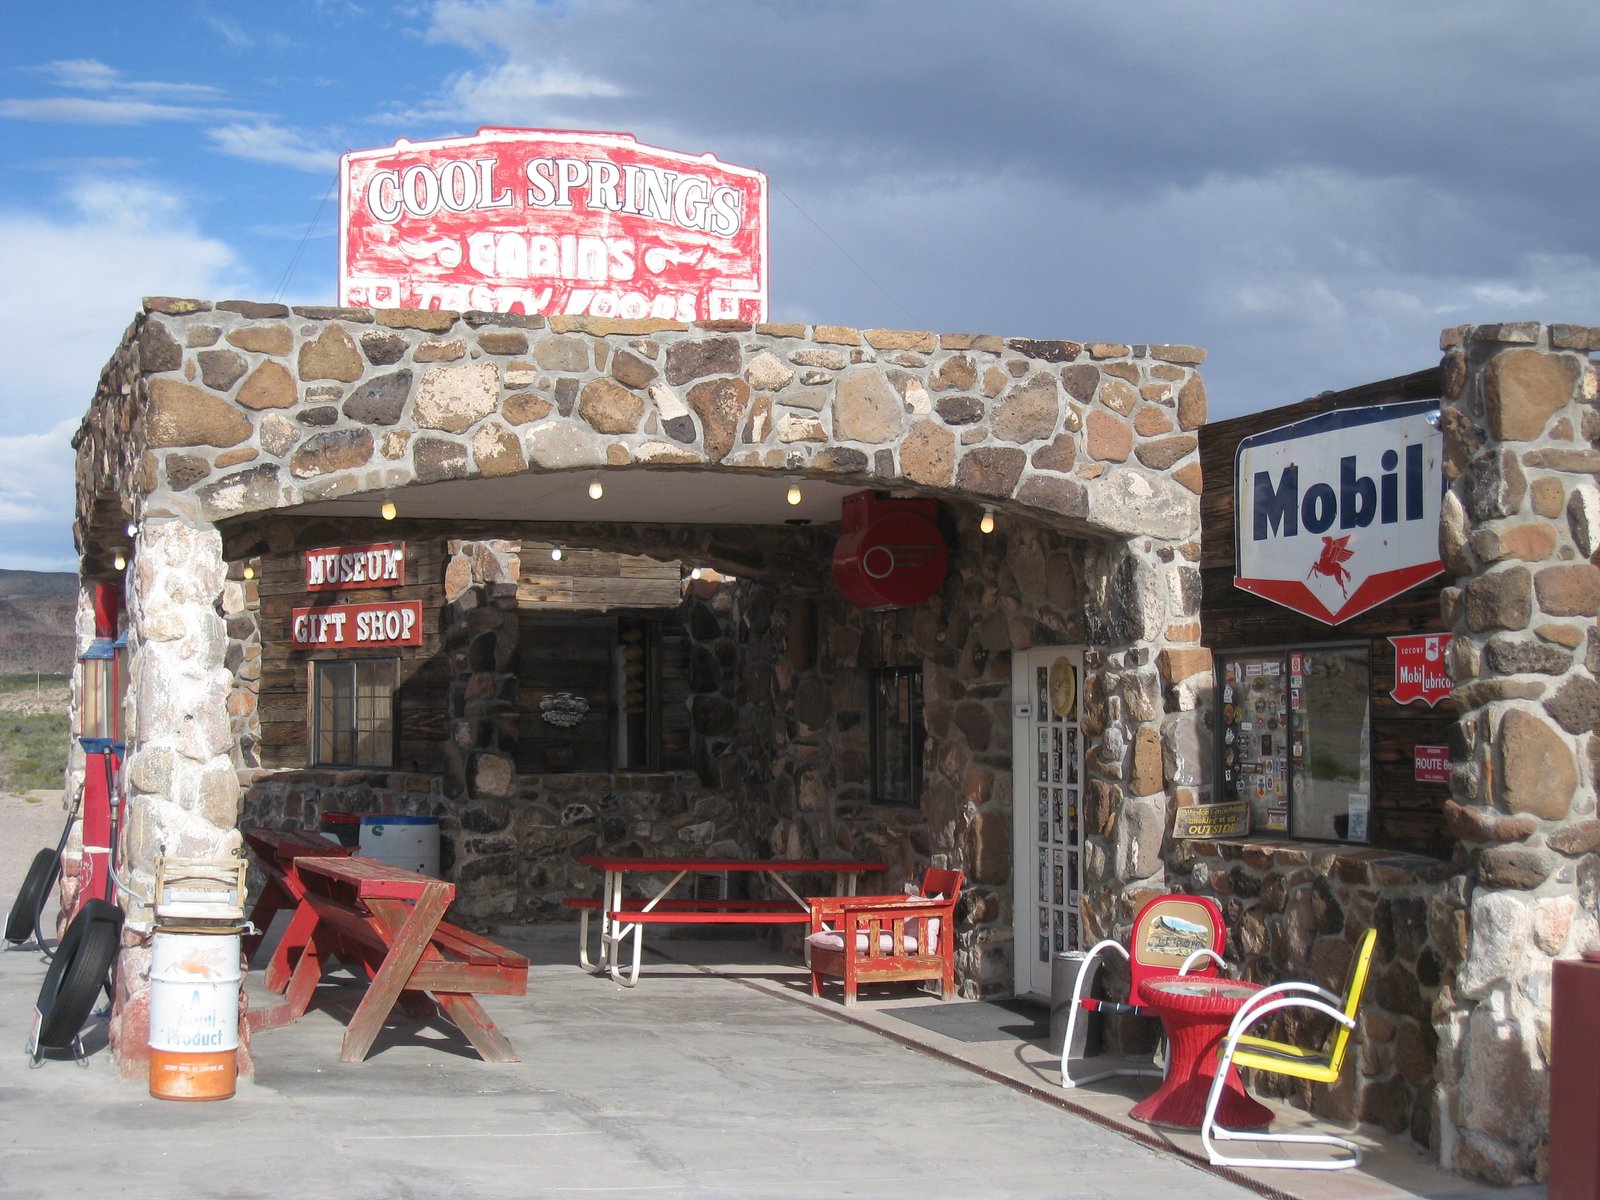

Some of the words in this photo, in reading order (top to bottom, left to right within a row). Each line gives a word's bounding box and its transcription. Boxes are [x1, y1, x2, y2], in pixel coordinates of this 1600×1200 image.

[367, 158, 514, 224] COOL
[525, 157, 740, 238] SPRINGS
[467, 231, 637, 281] CABINS
[1253, 443, 1424, 541] Mobil
[308, 548, 400, 586] MUSEUM
[294, 612, 347, 643] GIFT
[356, 608, 416, 641] SHOP
[1415, 757, 1442, 770] ROUTE
[1188, 824, 1236, 835] OUTSIDE
